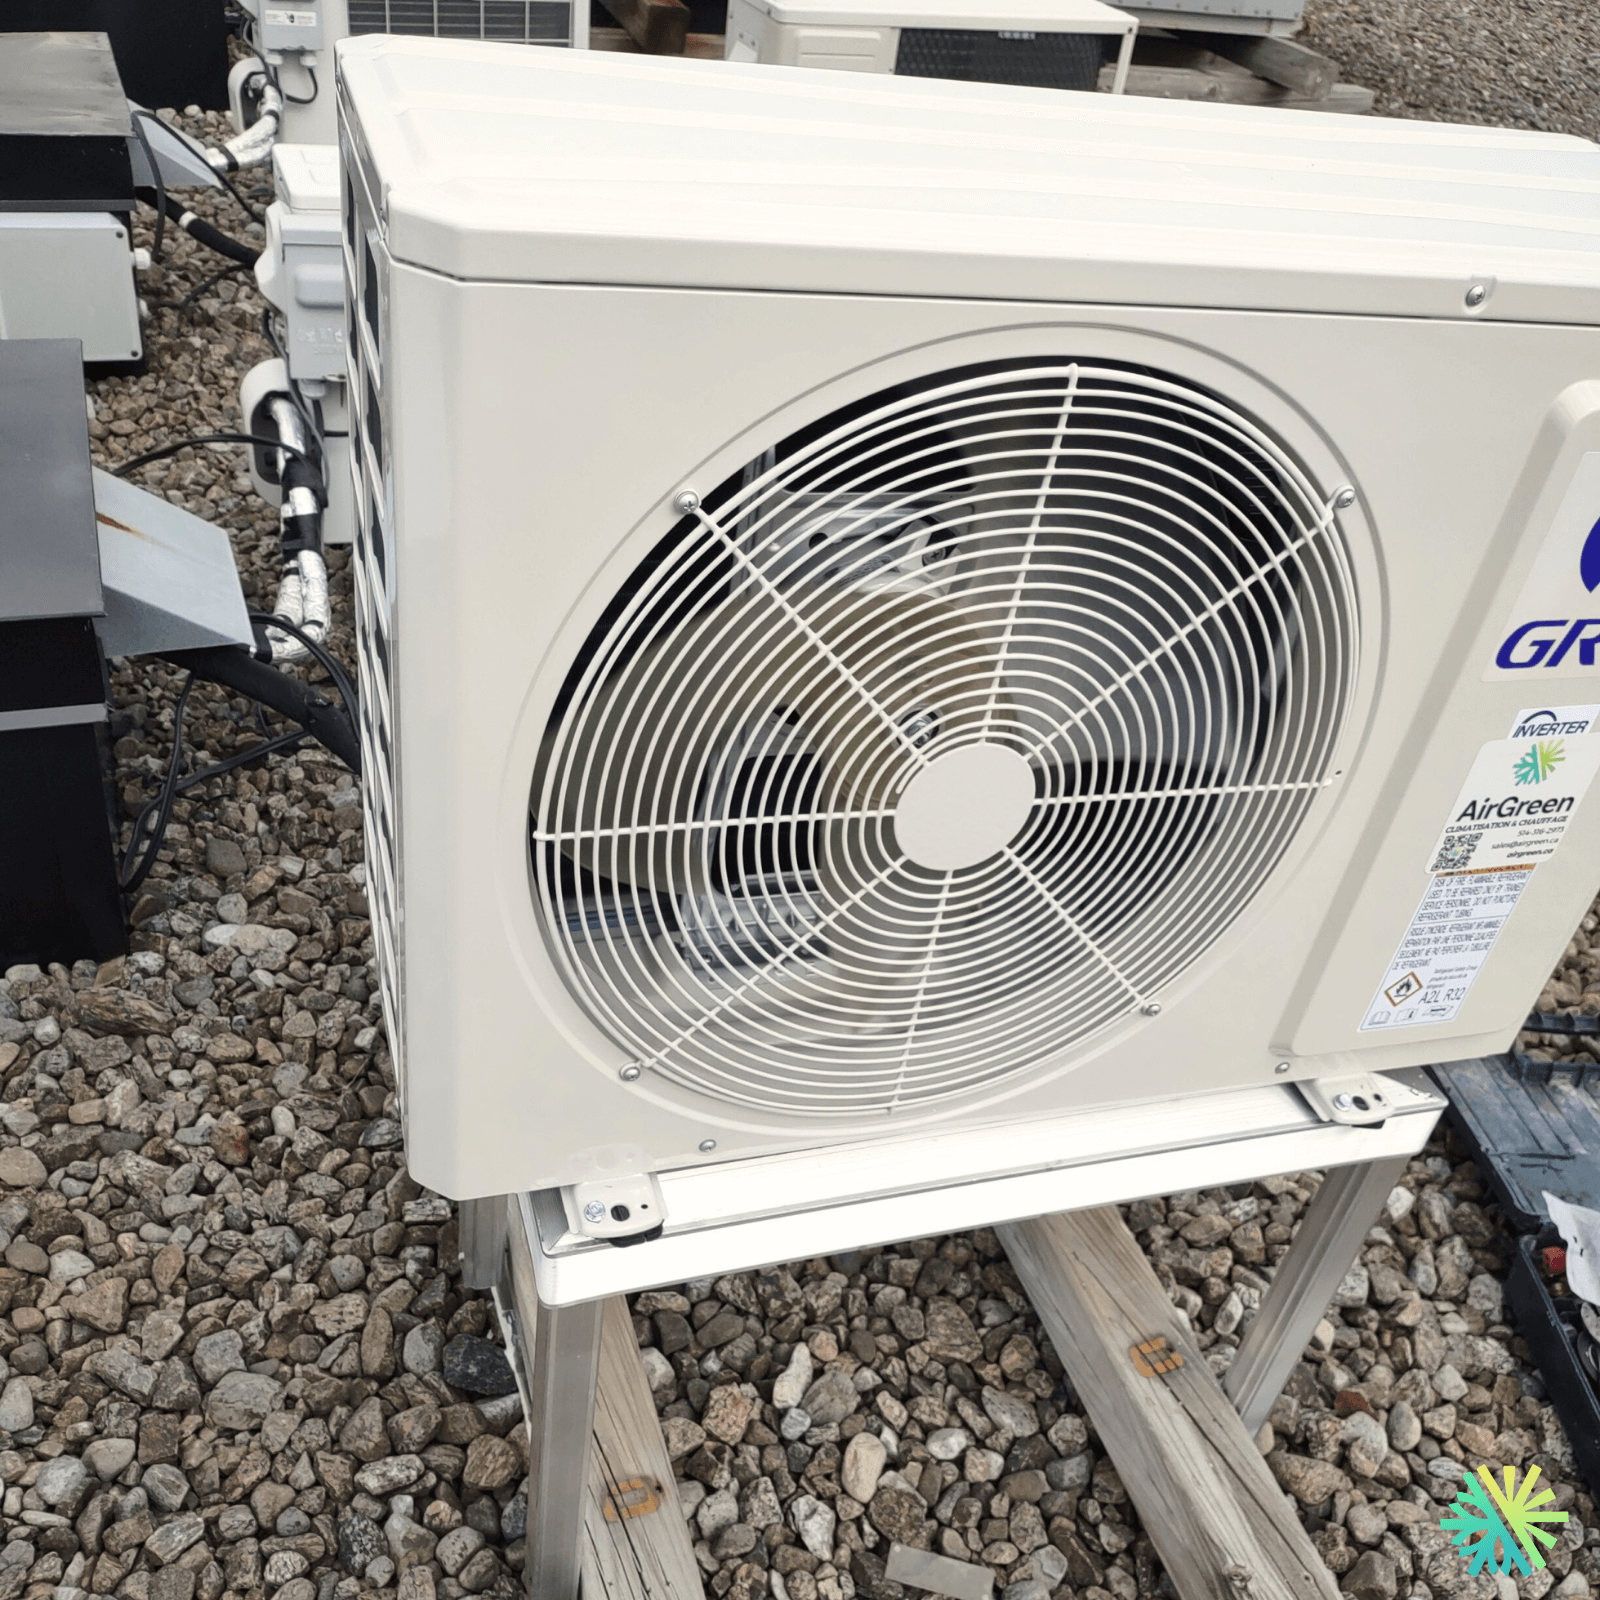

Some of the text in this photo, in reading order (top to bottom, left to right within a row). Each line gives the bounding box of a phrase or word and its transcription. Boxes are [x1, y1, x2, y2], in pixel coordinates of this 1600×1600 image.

[1512, 720, 1590, 738] INVERTER
[1456, 796, 1575, 822] AirGreen
[1445, 820, 1511, 834] CLIMATISATION
[1518, 815, 1569, 827] CHAUFFAGE
[1491, 837, 1559, 850] sales@airgreen.ca
[1506, 848, 1553, 859] airgreen.ca
[1418, 987, 1466, 1004] A2L R32
